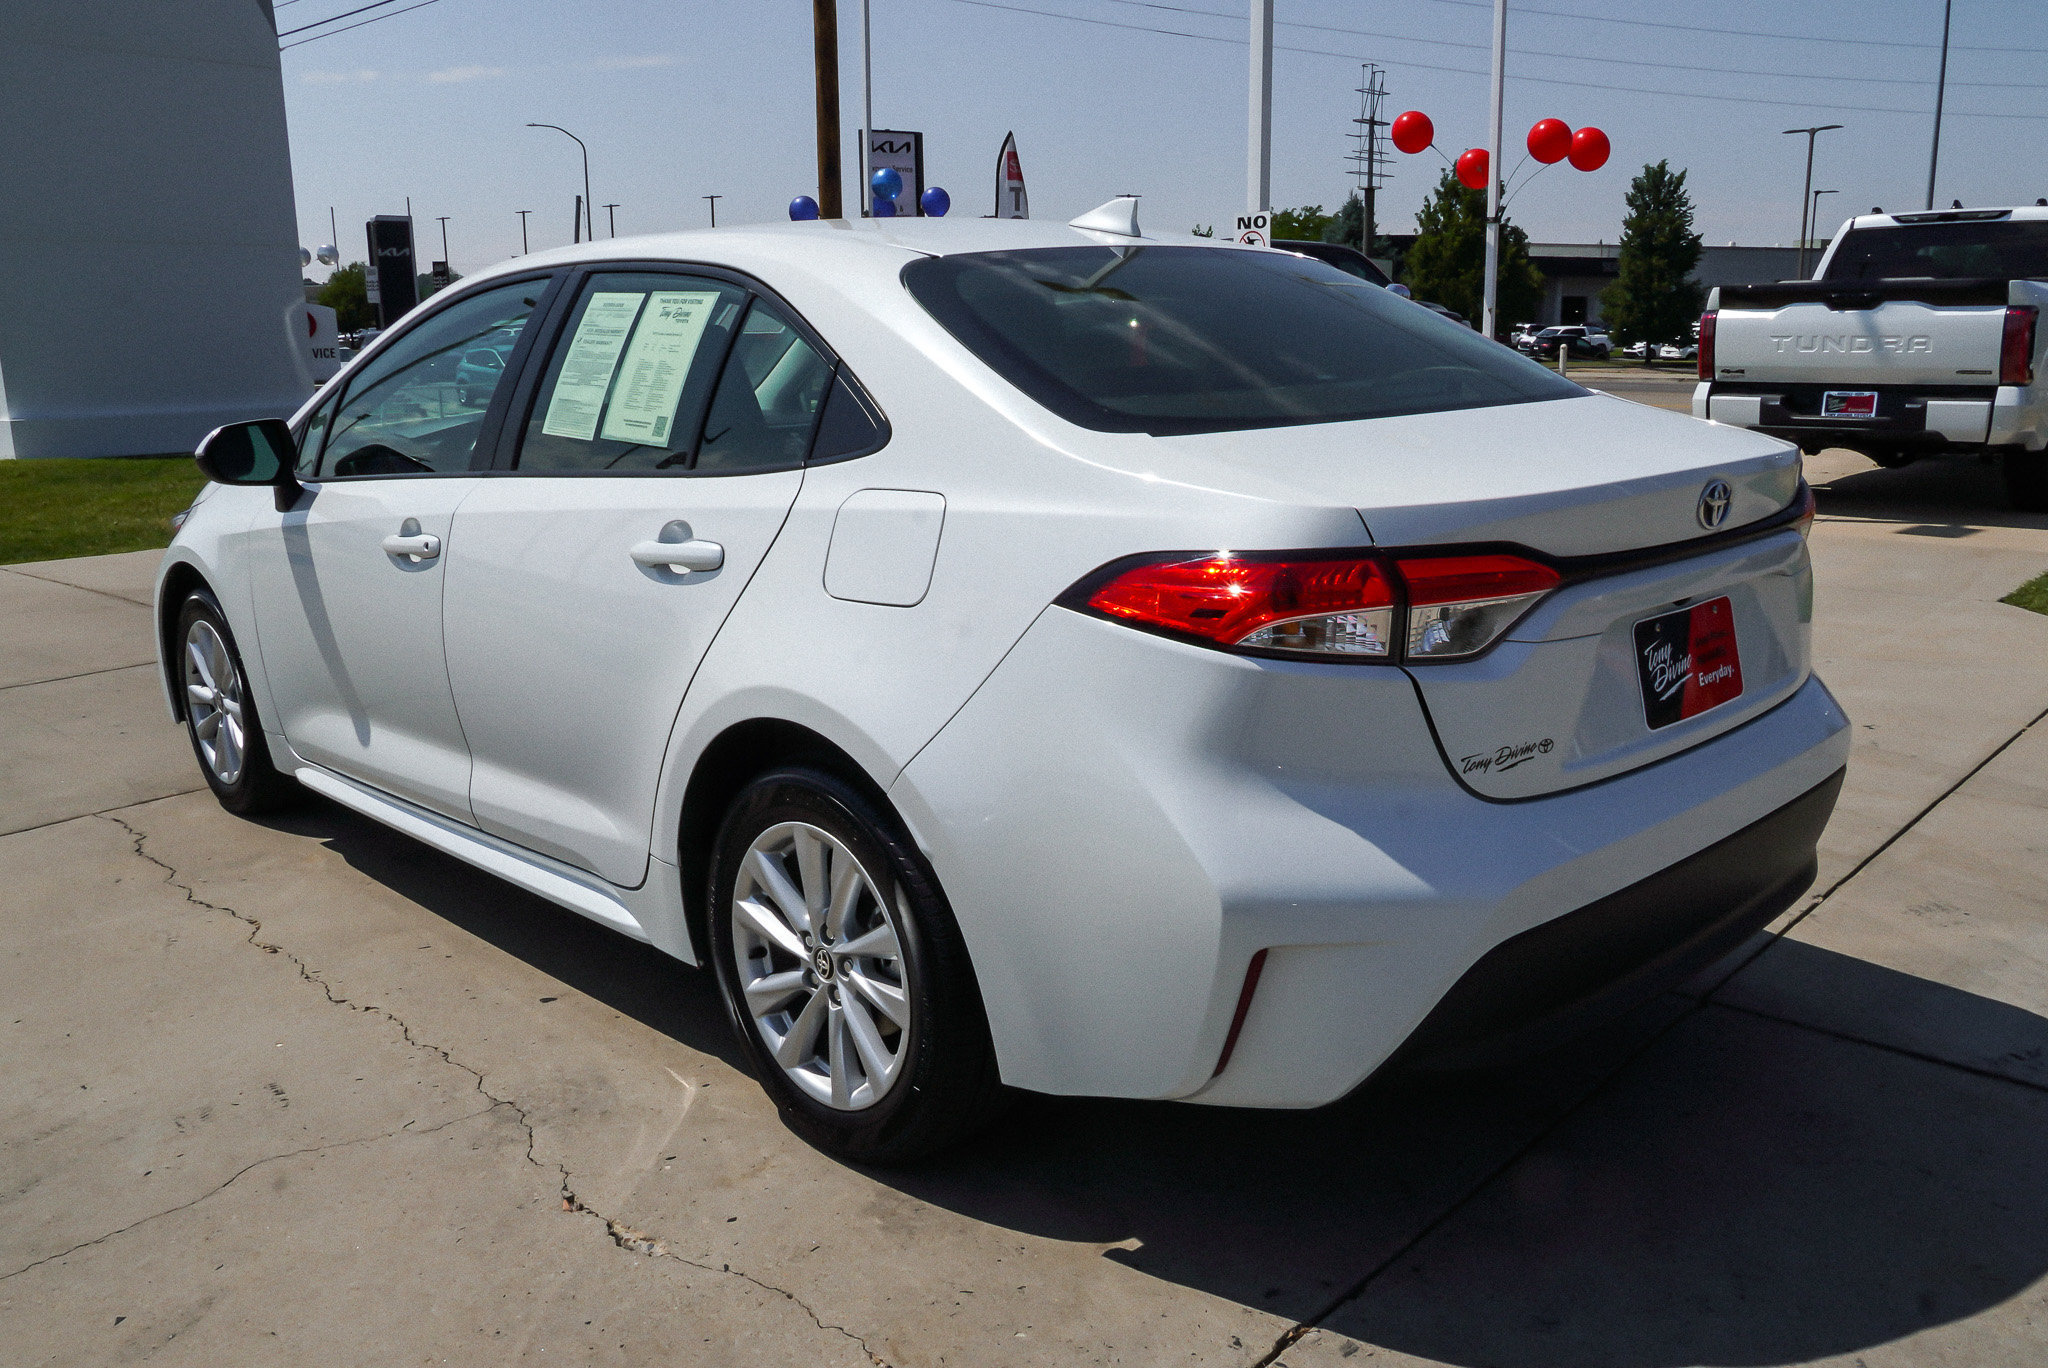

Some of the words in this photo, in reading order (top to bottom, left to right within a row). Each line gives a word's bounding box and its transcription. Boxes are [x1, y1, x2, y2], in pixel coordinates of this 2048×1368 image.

[1237, 215, 1267, 230] NO
[1770, 334, 1933, 354] TUNDRA
[1644, 638, 1673, 671] Tony
[1651, 653, 1693, 693] Divino
[1698, 664, 1735, 687] Everyday.
[1460, 752, 1493, 774] Tony
[1494, 741, 1537, 766] Divino
